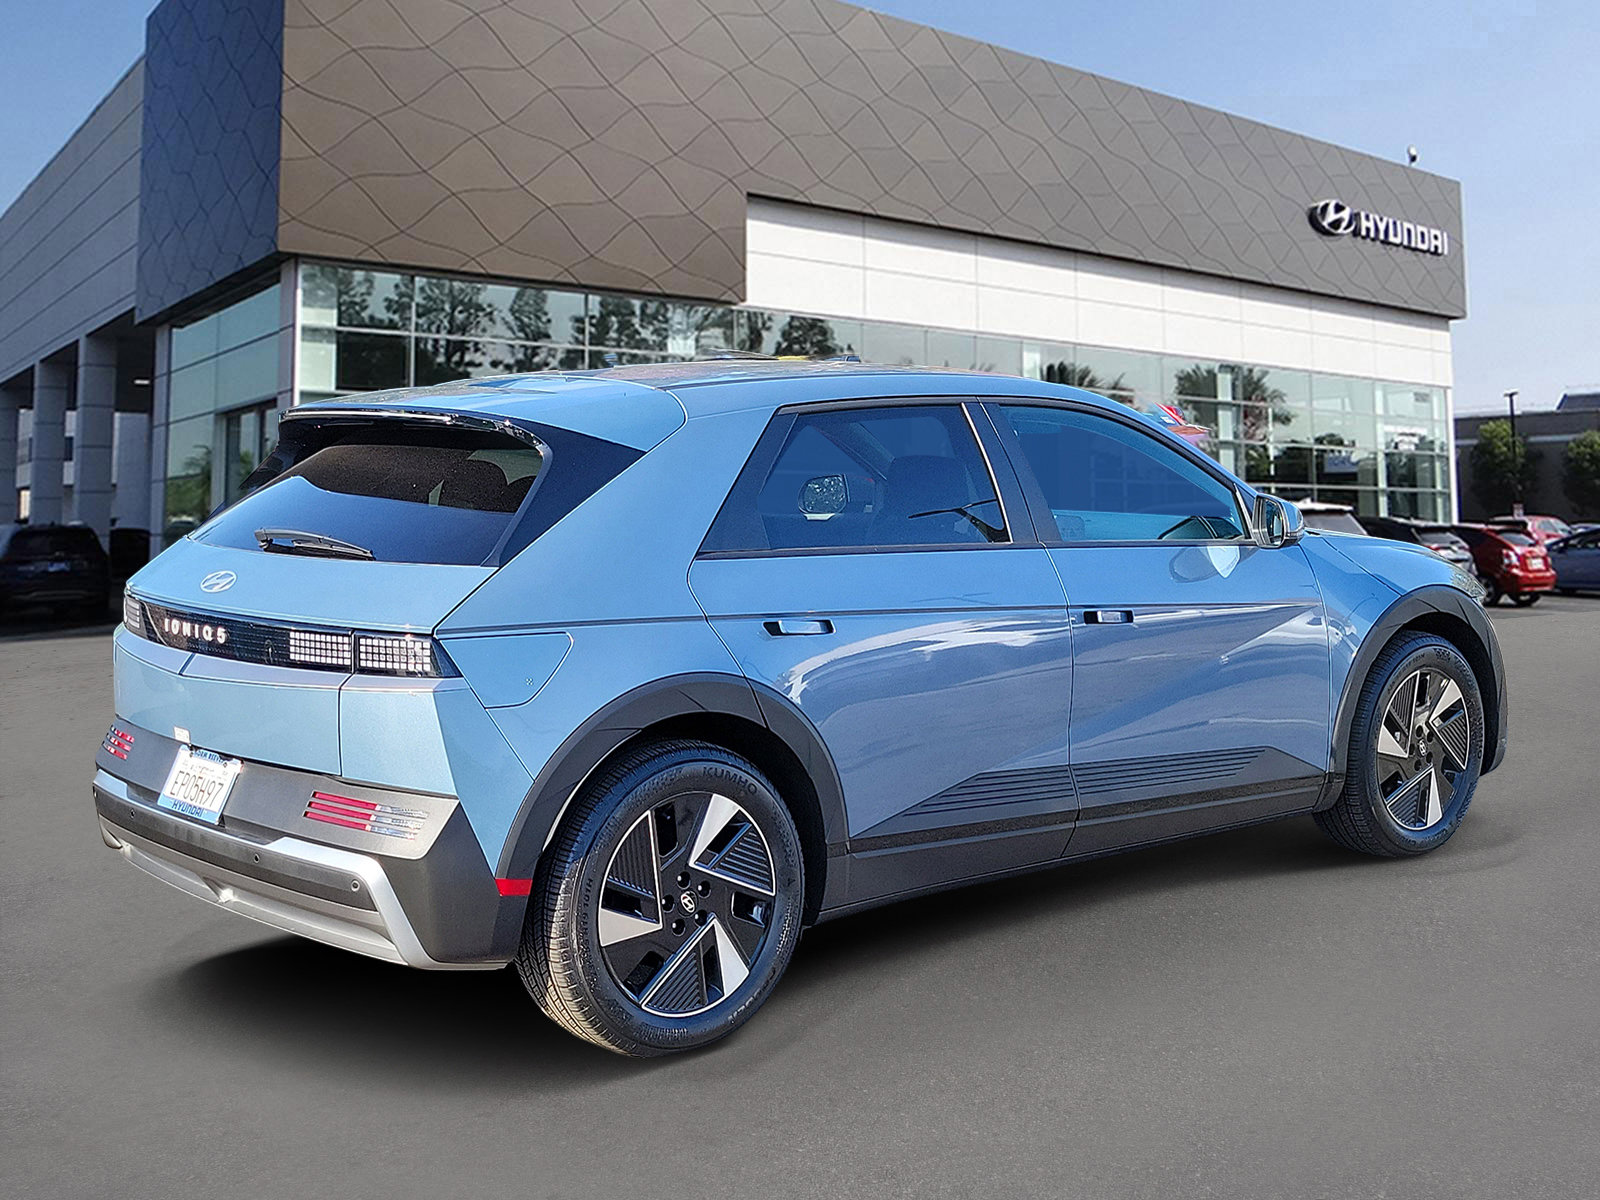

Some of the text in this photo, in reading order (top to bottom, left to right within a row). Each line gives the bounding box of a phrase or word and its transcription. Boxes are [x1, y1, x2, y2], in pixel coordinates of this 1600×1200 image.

[1360, 211, 1448, 255] HYUNDAI
[164, 617, 227, 644] IONIQ 5
[170, 770, 224, 807] EP05H97
[702, 766, 758, 794] KUMHO
[172, 800, 204, 817] HYUNDAI
